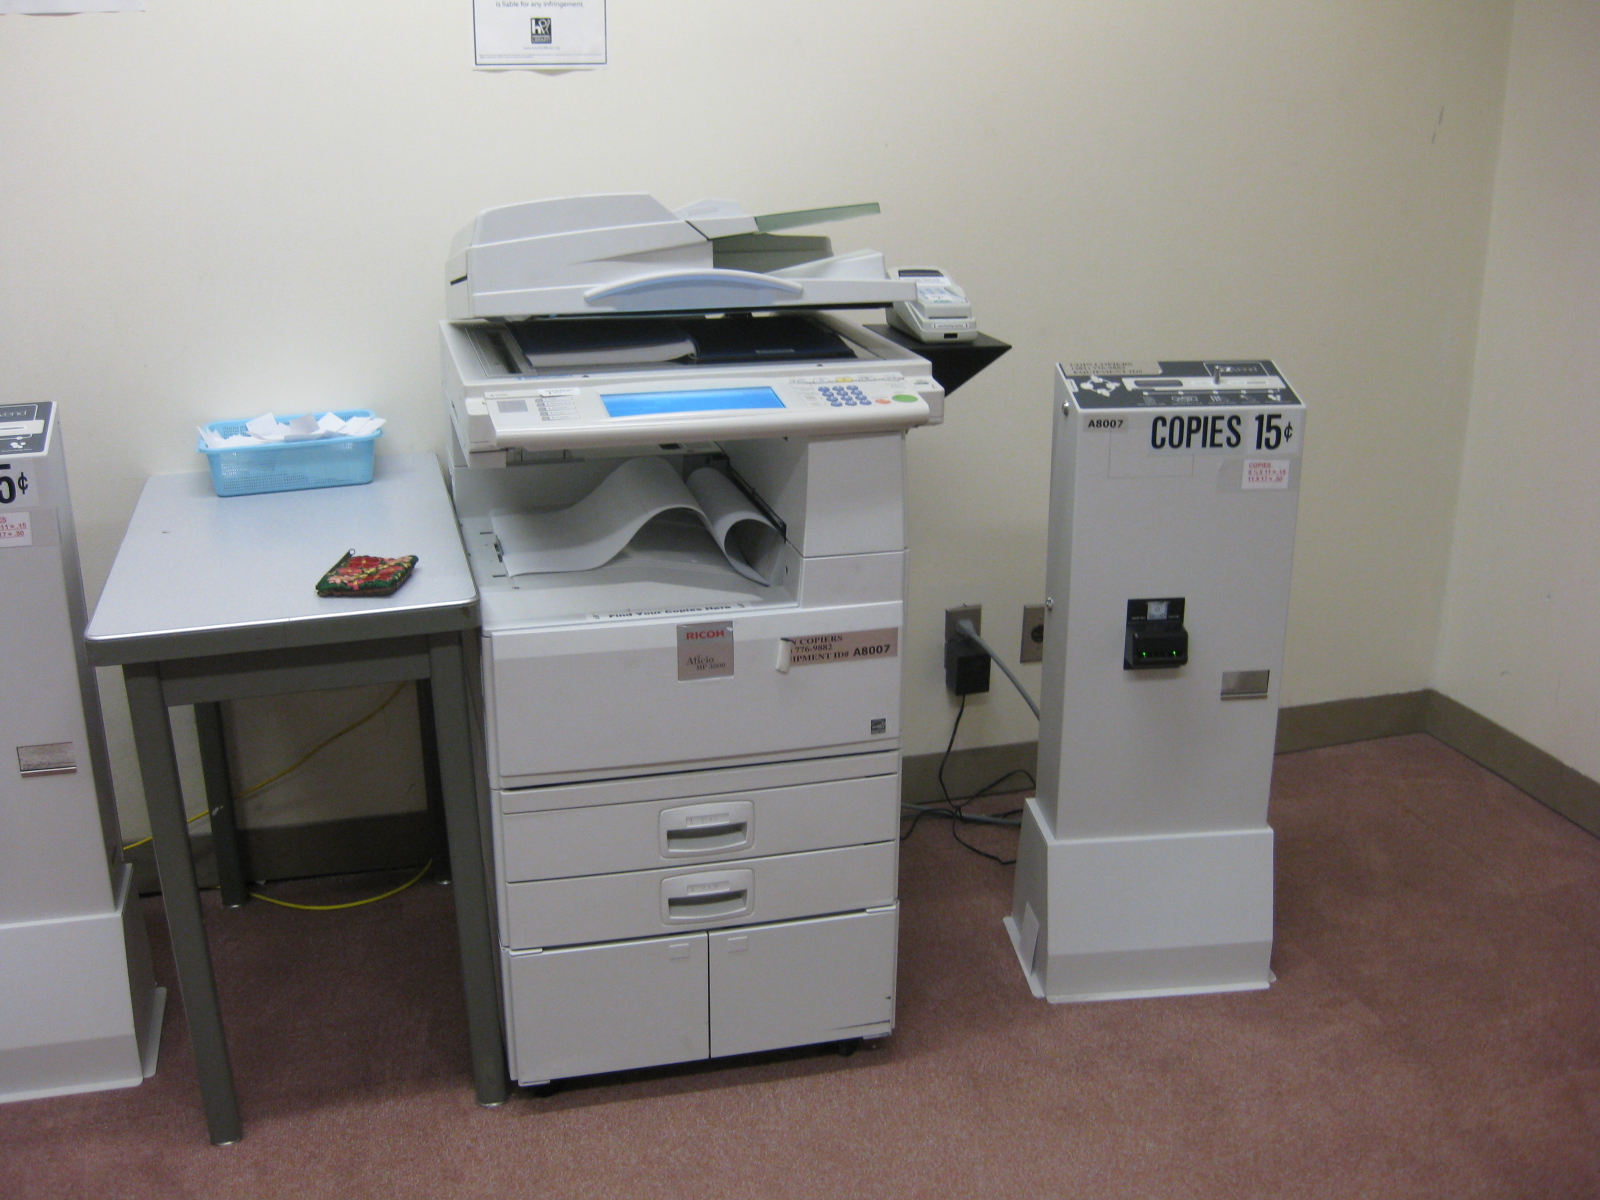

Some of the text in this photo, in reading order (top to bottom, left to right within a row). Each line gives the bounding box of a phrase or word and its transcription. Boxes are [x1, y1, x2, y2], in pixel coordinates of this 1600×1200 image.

[543, 1, 584, 9] infringement.
[1087, 419, 1124, 429] A8007
[1150, 414, 1293, 451] COPIES 15¢
[686, 630, 725, 640] RICOH
[799, 635, 843, 645] COPIERS
[795, 643, 833, 653] 776-9882
[853, 644, 891, 657] A8007
[687, 654, 714, 665] Aficio
